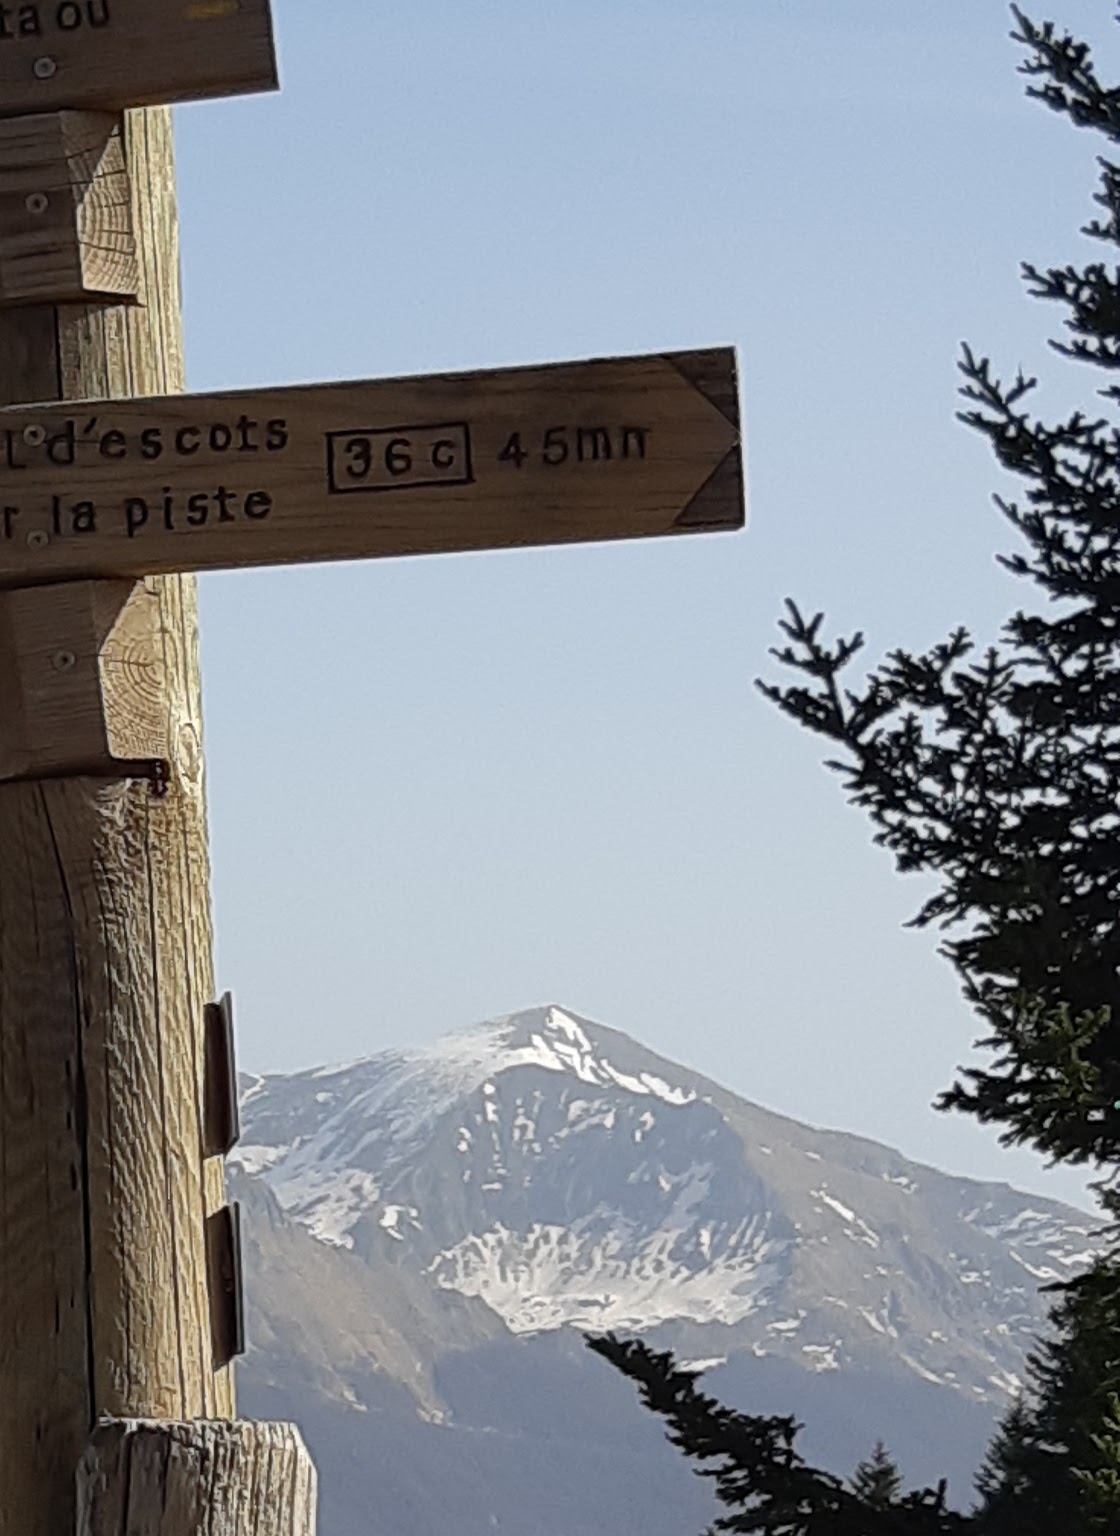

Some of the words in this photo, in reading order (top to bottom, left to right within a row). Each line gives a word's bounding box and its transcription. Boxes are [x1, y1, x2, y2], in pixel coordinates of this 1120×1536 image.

[46, 415, 288, 465] d'escots
[498, 426, 651, 469] 45mn
[52, 495, 96, 535] la
[125, 486, 272, 538] piste
